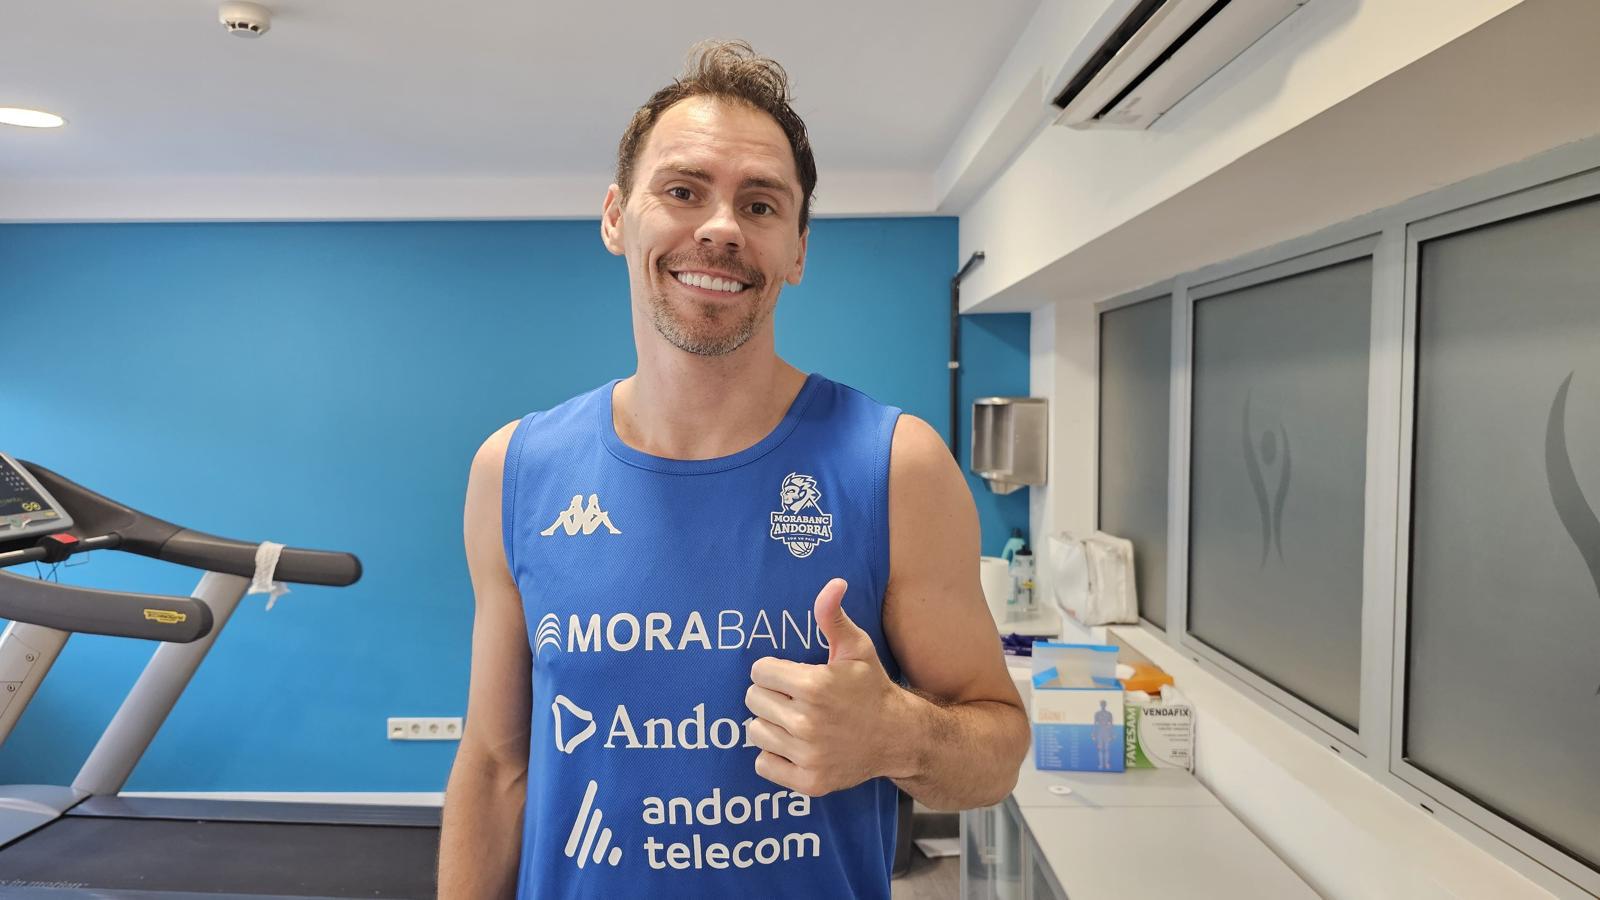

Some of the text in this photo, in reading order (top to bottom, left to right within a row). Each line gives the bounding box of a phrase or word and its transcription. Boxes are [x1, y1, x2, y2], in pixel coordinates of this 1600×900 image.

[773, 514, 829, 525] MORABANC
[773, 523, 830, 537] ANDORRA
[1142, 707, 1189, 717] VENDAFIX
[1125, 704, 1137, 767] FAVESAM
[642, 787, 811, 826] andorra
[643, 832, 821, 870] telecom
